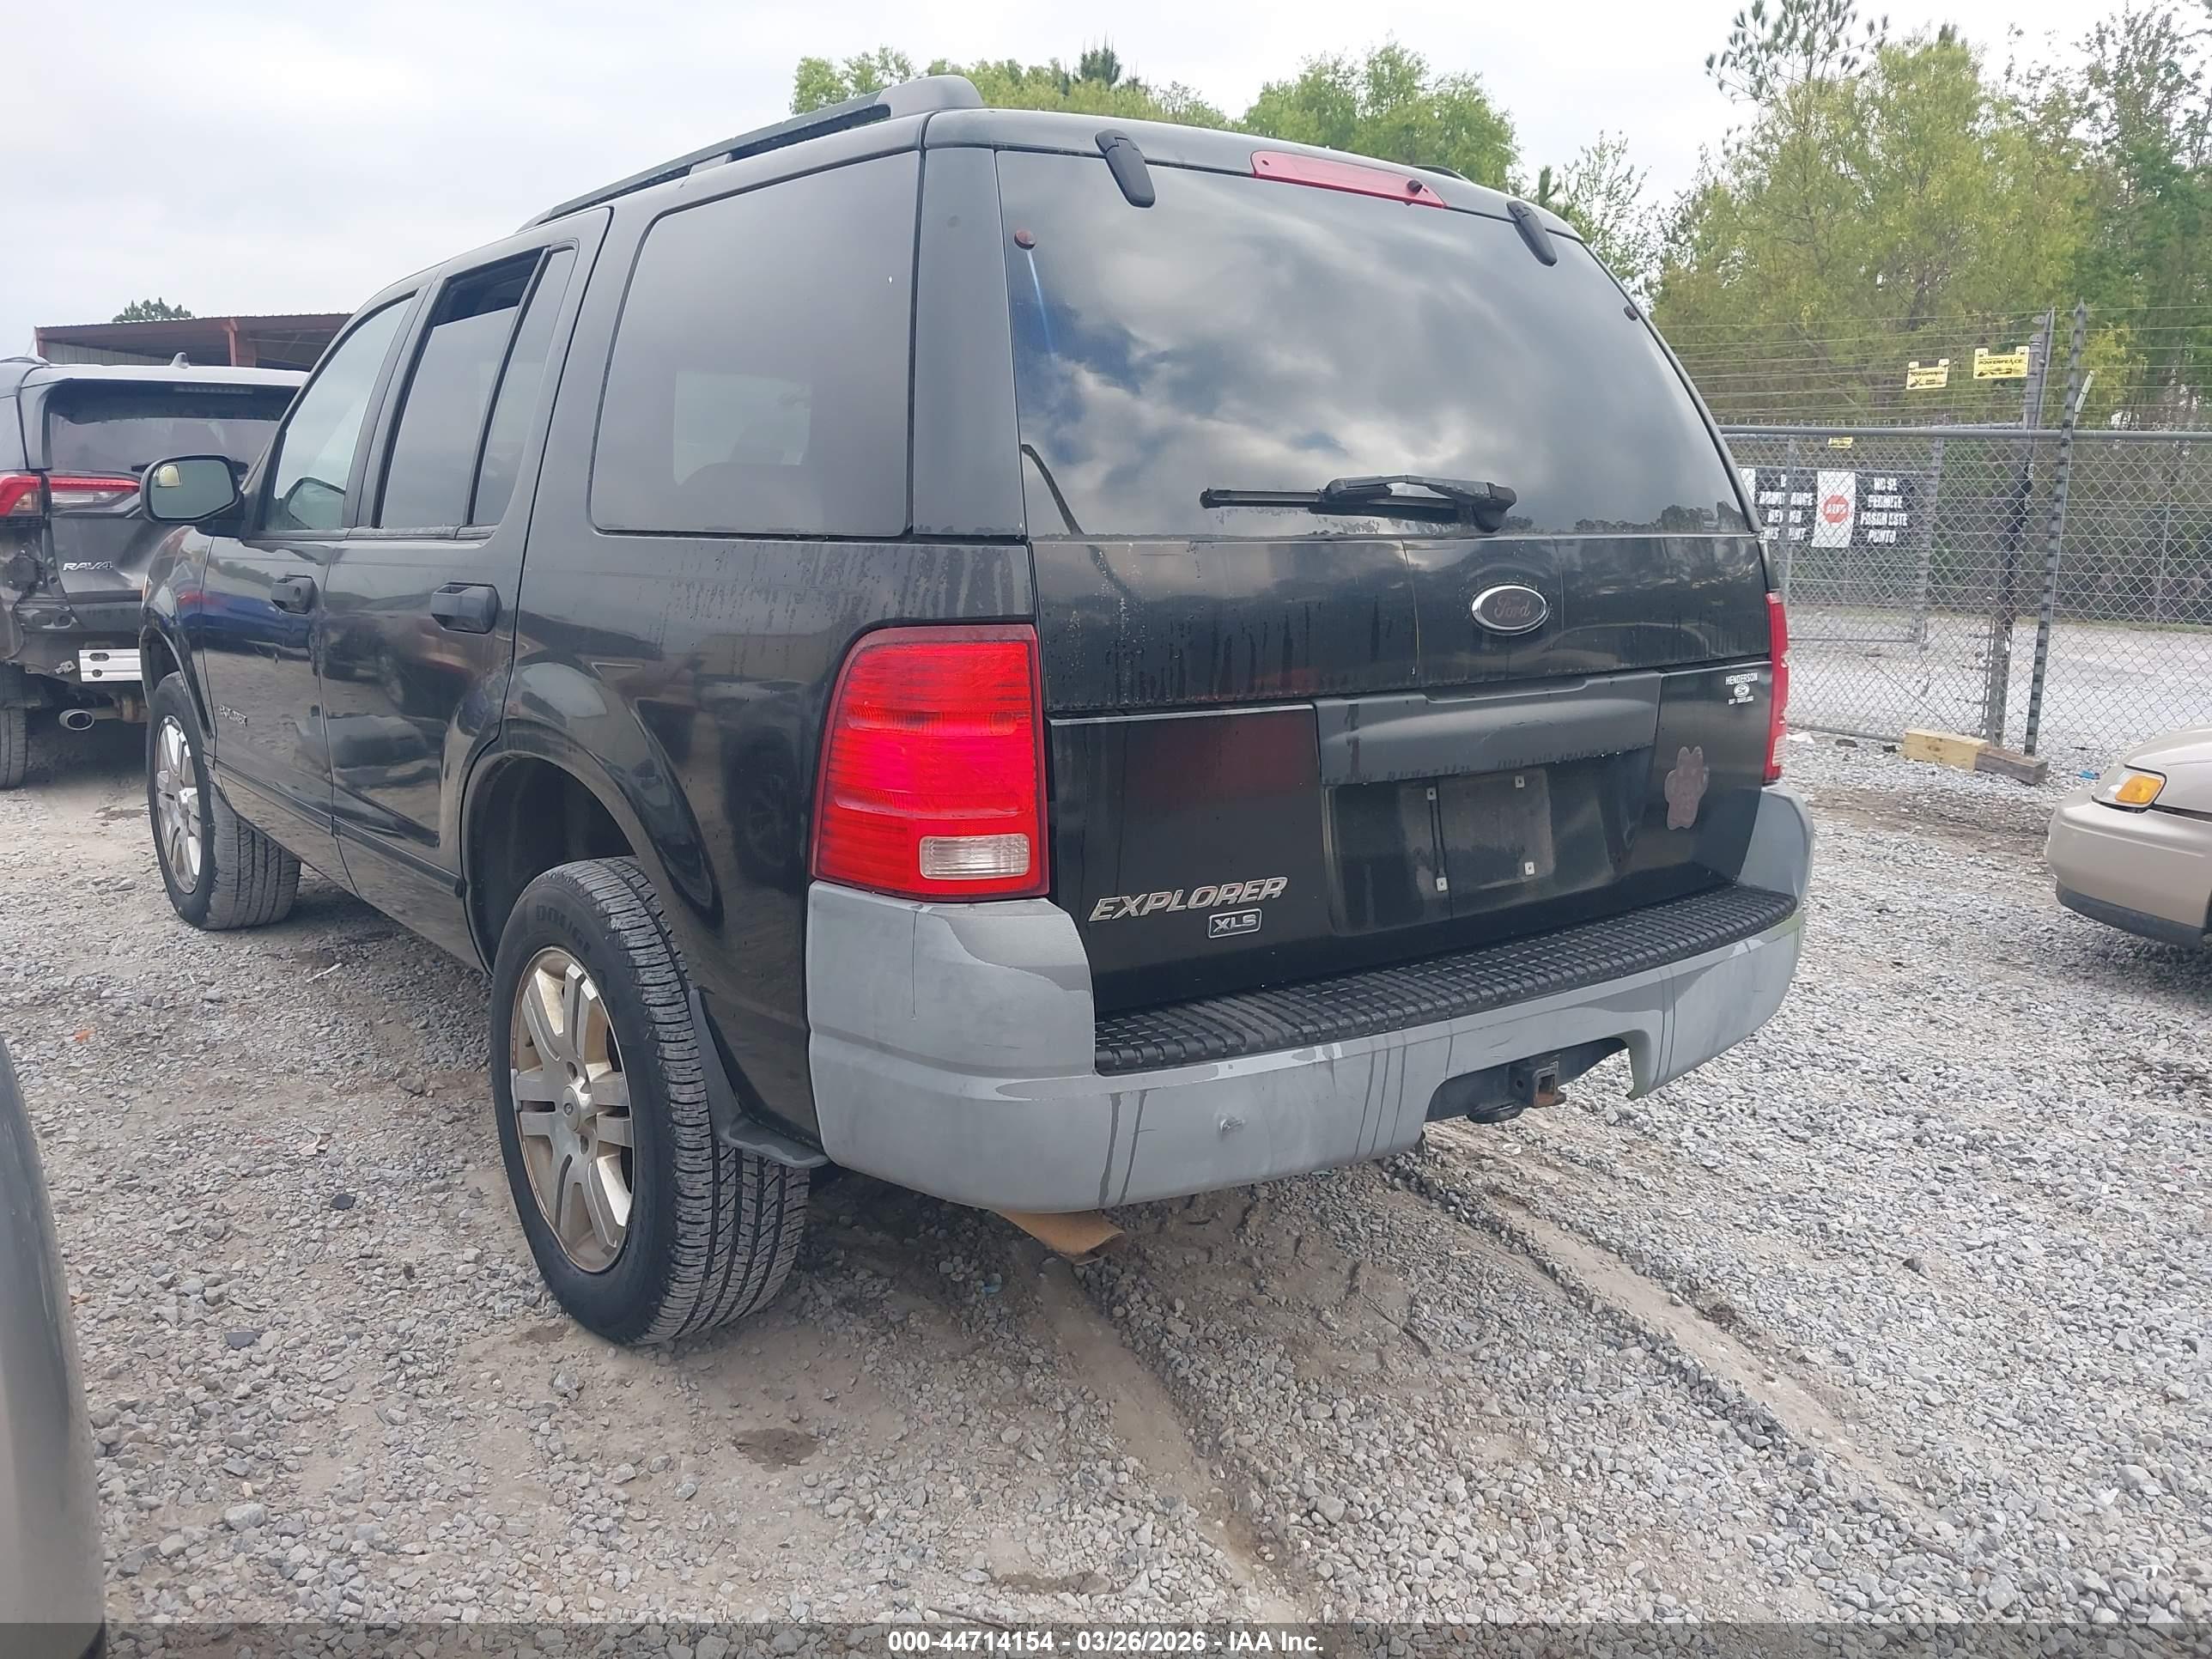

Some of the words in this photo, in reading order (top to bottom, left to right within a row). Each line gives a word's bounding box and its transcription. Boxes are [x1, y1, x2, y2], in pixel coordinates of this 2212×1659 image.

[63, 561, 114, 571] RAV4
[1494, 596, 1531, 618] Ford
[1726, 672, 1758, 685] HENDERSON
[1088, 877, 1288, 922] EXPLORER
[1213, 914, 1256, 933] XLS
